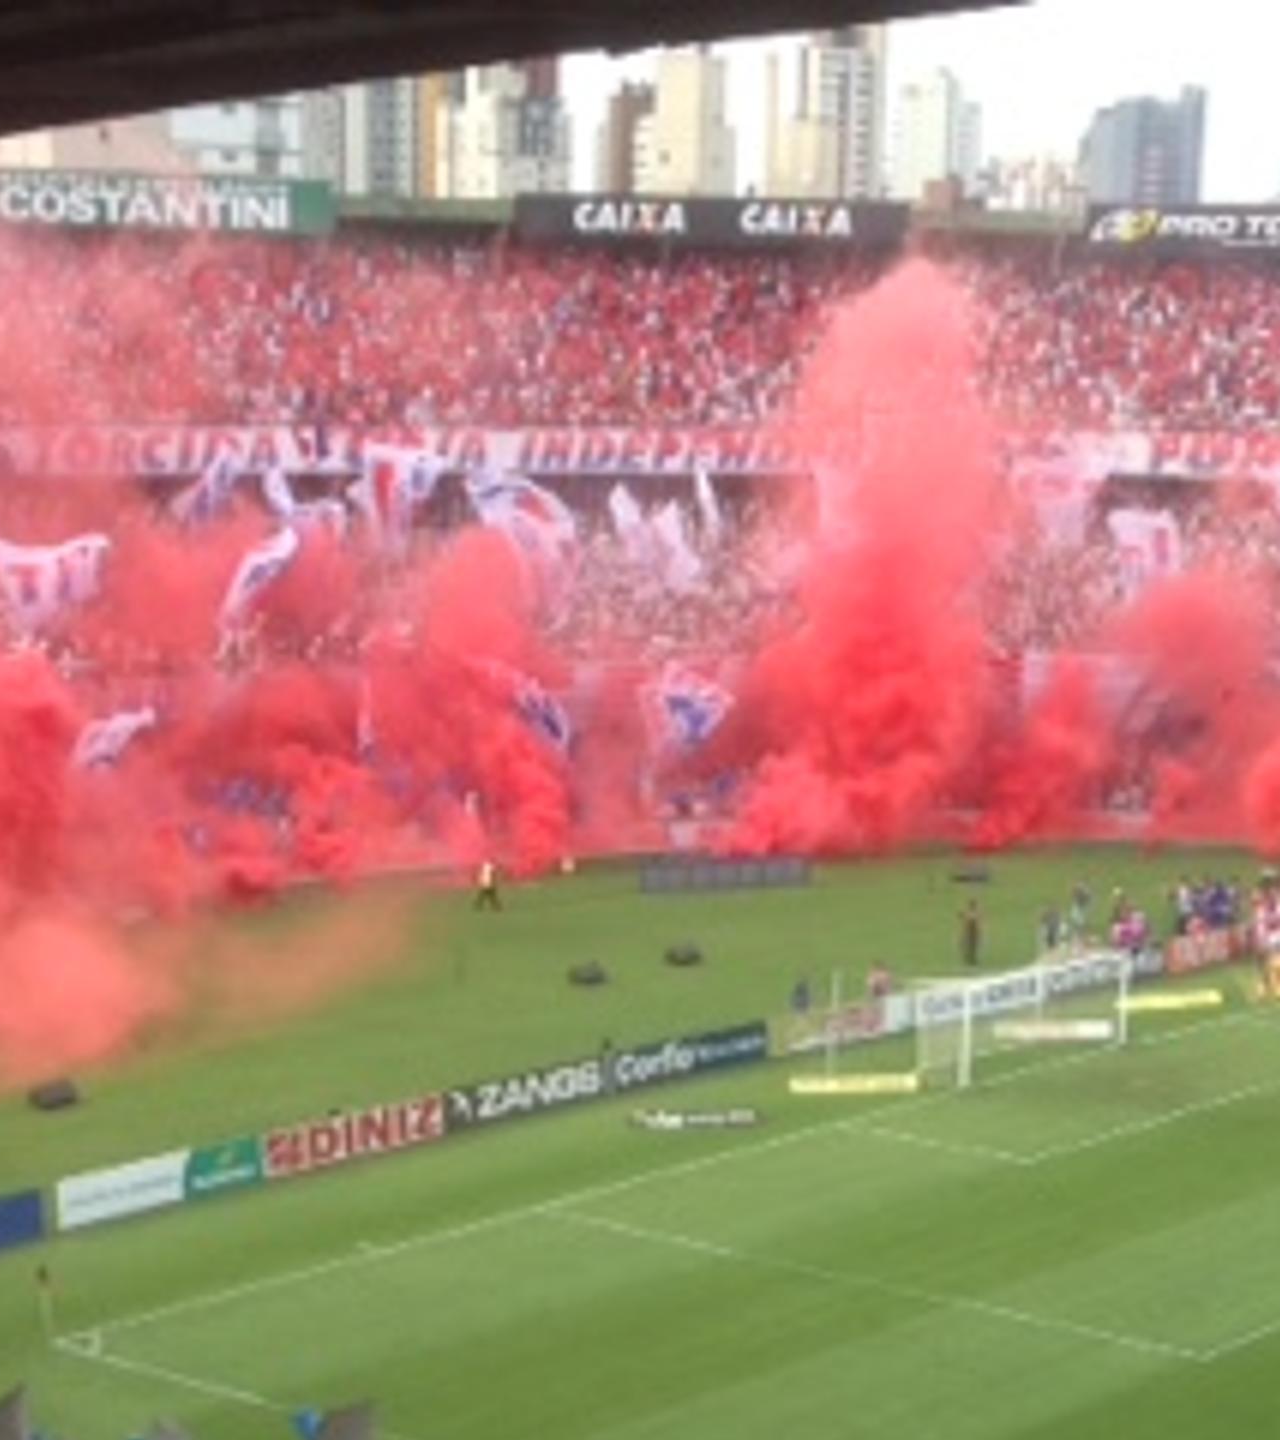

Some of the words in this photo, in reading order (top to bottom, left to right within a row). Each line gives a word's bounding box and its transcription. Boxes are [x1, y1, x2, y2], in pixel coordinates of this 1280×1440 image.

[572, 202, 687, 234] CAIXA
[739, 203, 854, 236] CAIXA
[311, 1096, 443, 1164] DINIZ
